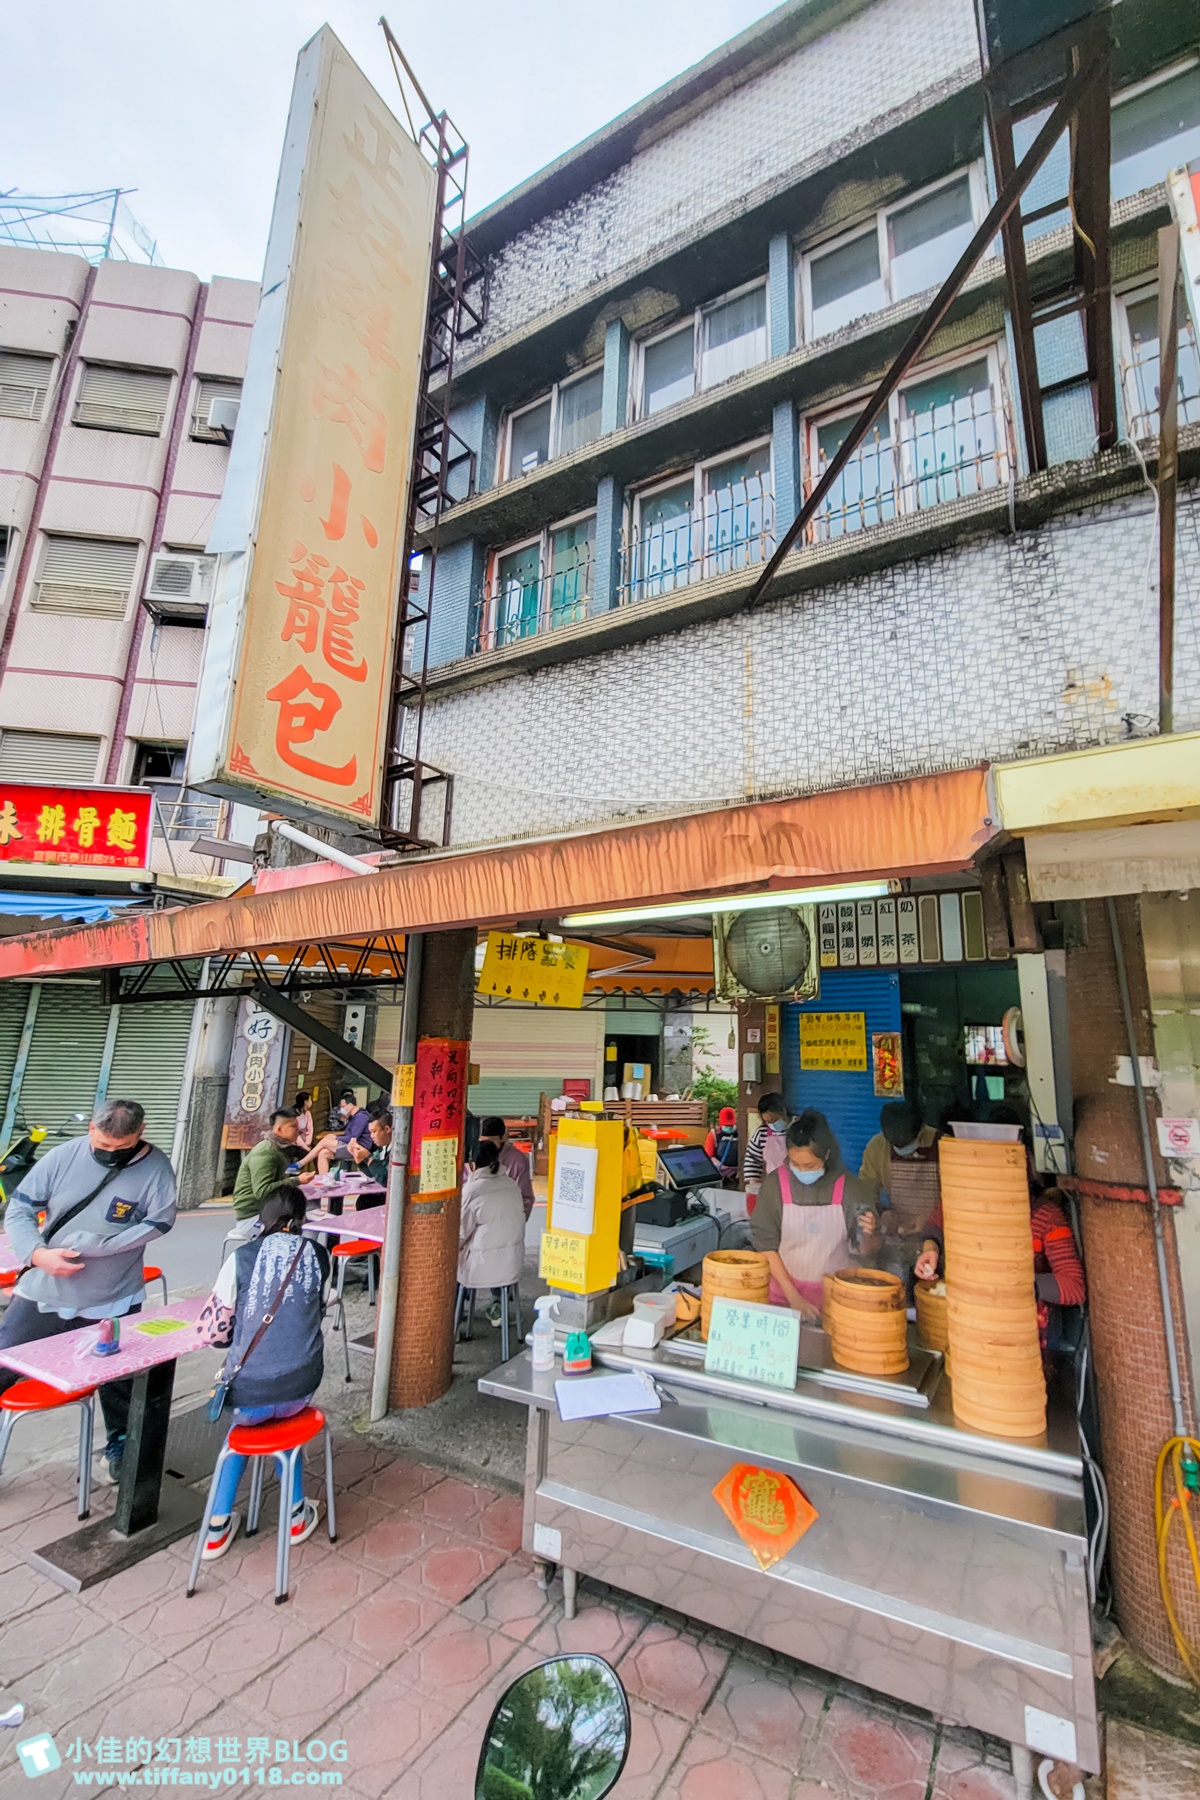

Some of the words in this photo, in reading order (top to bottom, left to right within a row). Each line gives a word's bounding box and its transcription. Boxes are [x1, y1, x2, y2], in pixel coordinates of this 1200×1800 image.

[266, 104, 412, 787] 正好鮮肉小籠包
[821, 907, 835, 950] 小籠包
[840, 905, 854, 950] 酸辣湯
[860, 904, 875, 948] 豆漿
[879, 902, 895, 947] 紅茶
[900, 900, 915, 946] 奶茶
[726, 1309, 790, 1337] 營業時間
